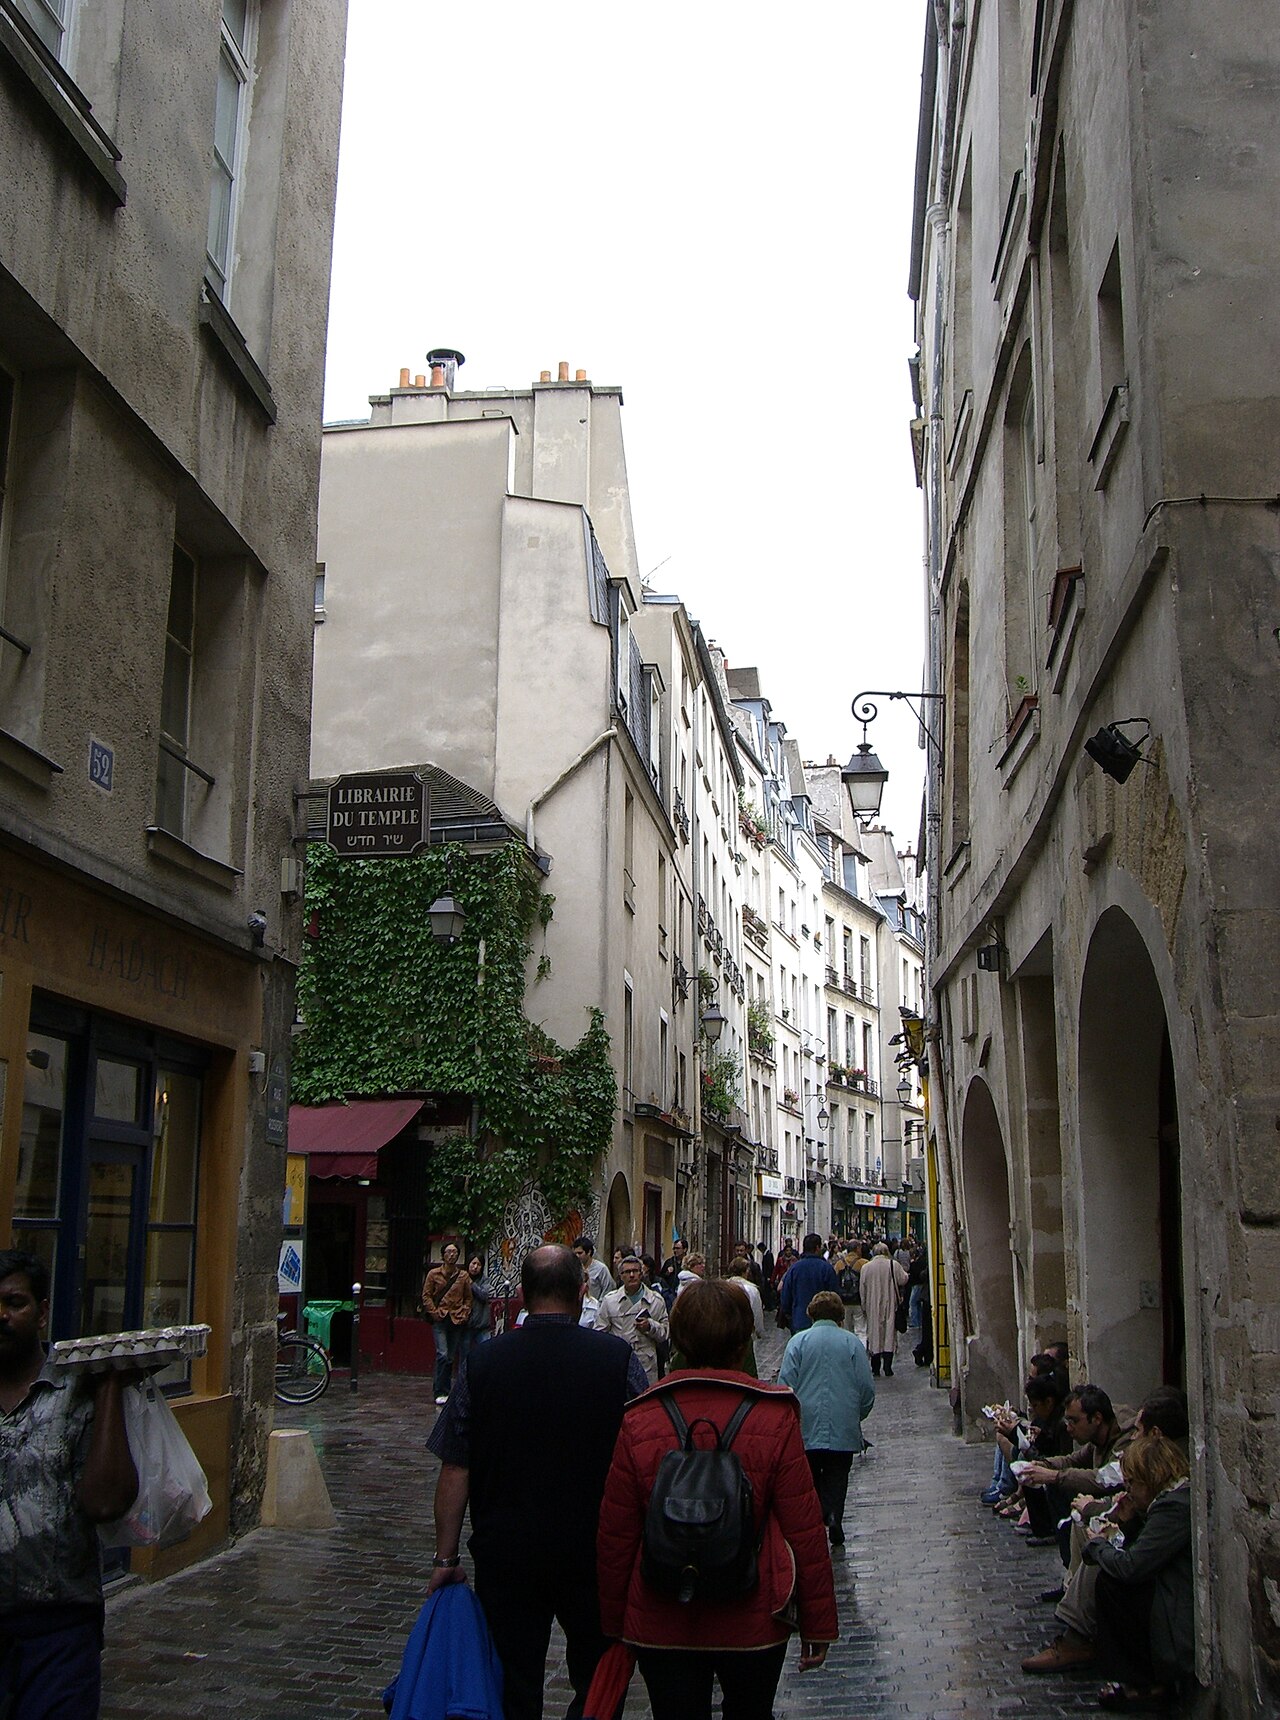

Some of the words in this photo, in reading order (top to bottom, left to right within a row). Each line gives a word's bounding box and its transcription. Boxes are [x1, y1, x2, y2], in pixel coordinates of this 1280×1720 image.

[93, 748, 110, 785] 52
[337, 786, 415, 805] LIBRAIRIE
[333, 811, 355, 827] DU
[359, 809, 419, 826] TEMPLE
[347, 835, 376, 847] חדש
[383, 834, 404, 846] שיר
